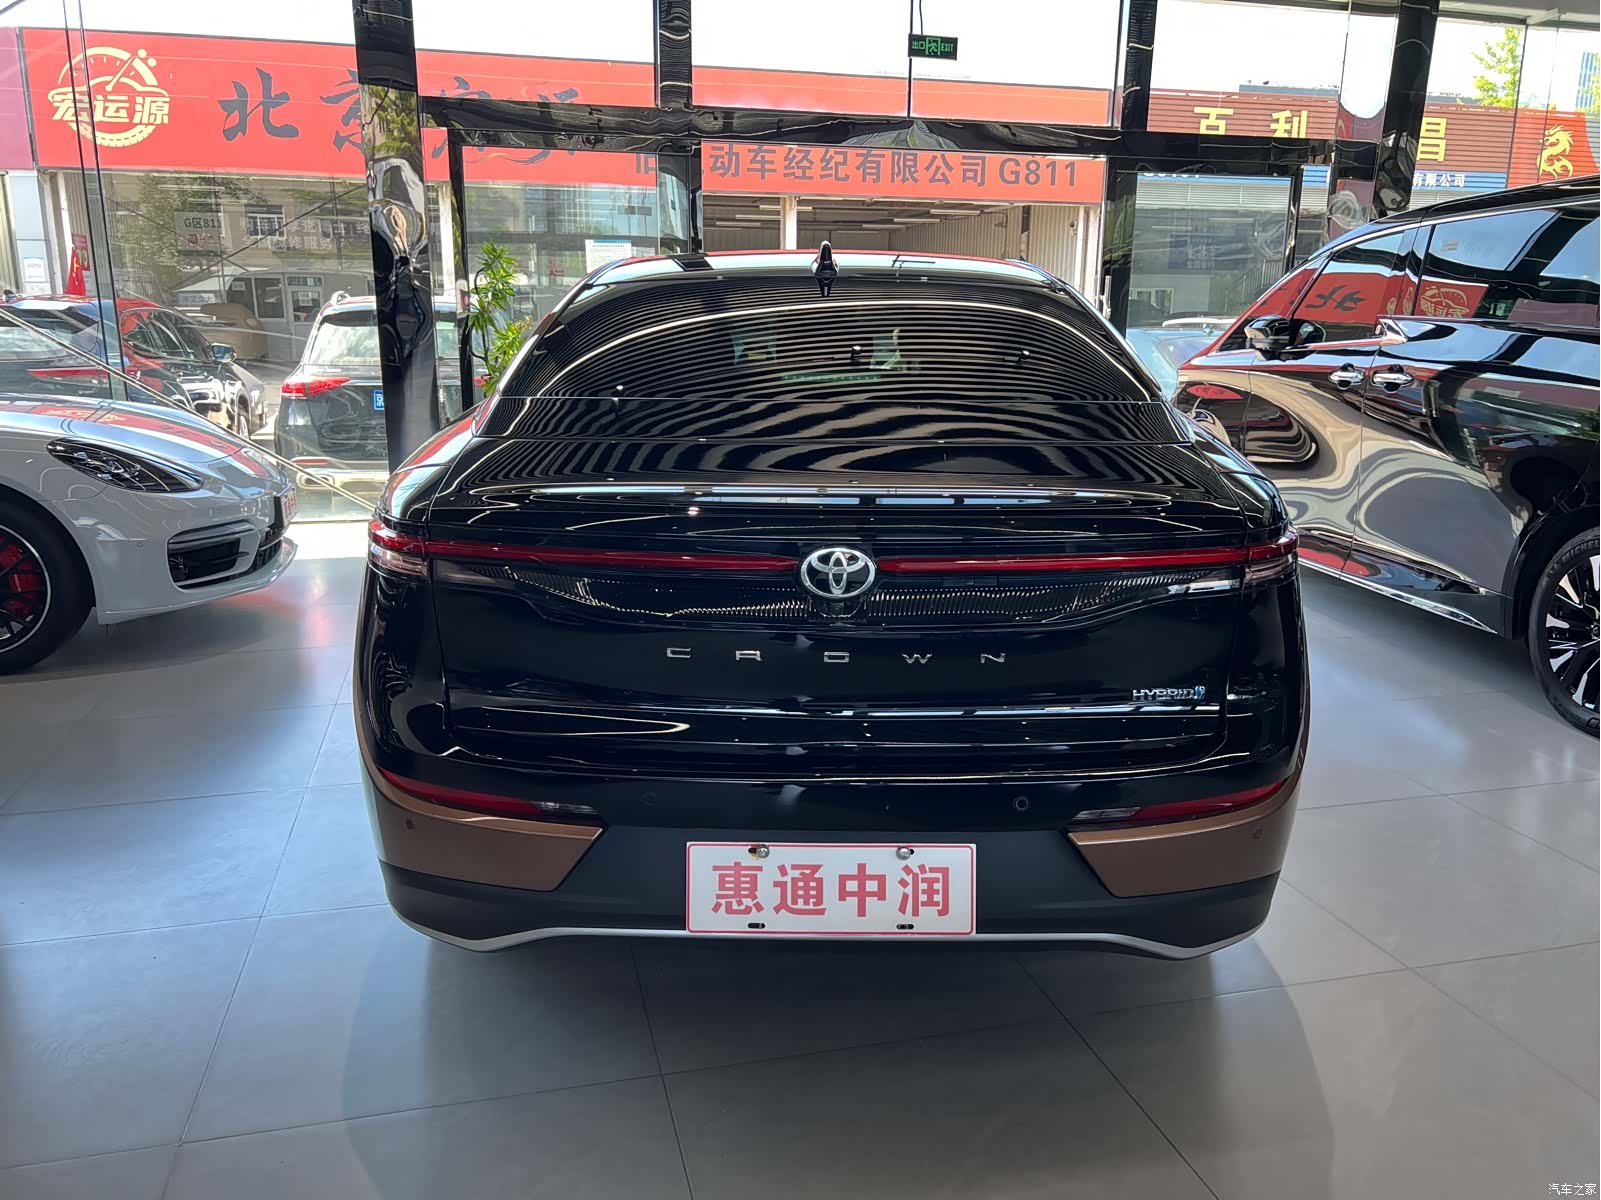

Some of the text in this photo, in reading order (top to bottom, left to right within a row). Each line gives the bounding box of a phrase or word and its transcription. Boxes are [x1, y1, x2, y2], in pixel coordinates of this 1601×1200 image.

[911, 40, 926, 50] 出口
[940, 43, 954, 52] EXIT
[51, 94, 171, 125] 宏运源
[998, 157, 1077, 188] G811
[665, 647, 1006, 664] CROWN
[1132, 687, 1195, 701] HYBRID
[711, 860, 950, 918] 惠通中润
